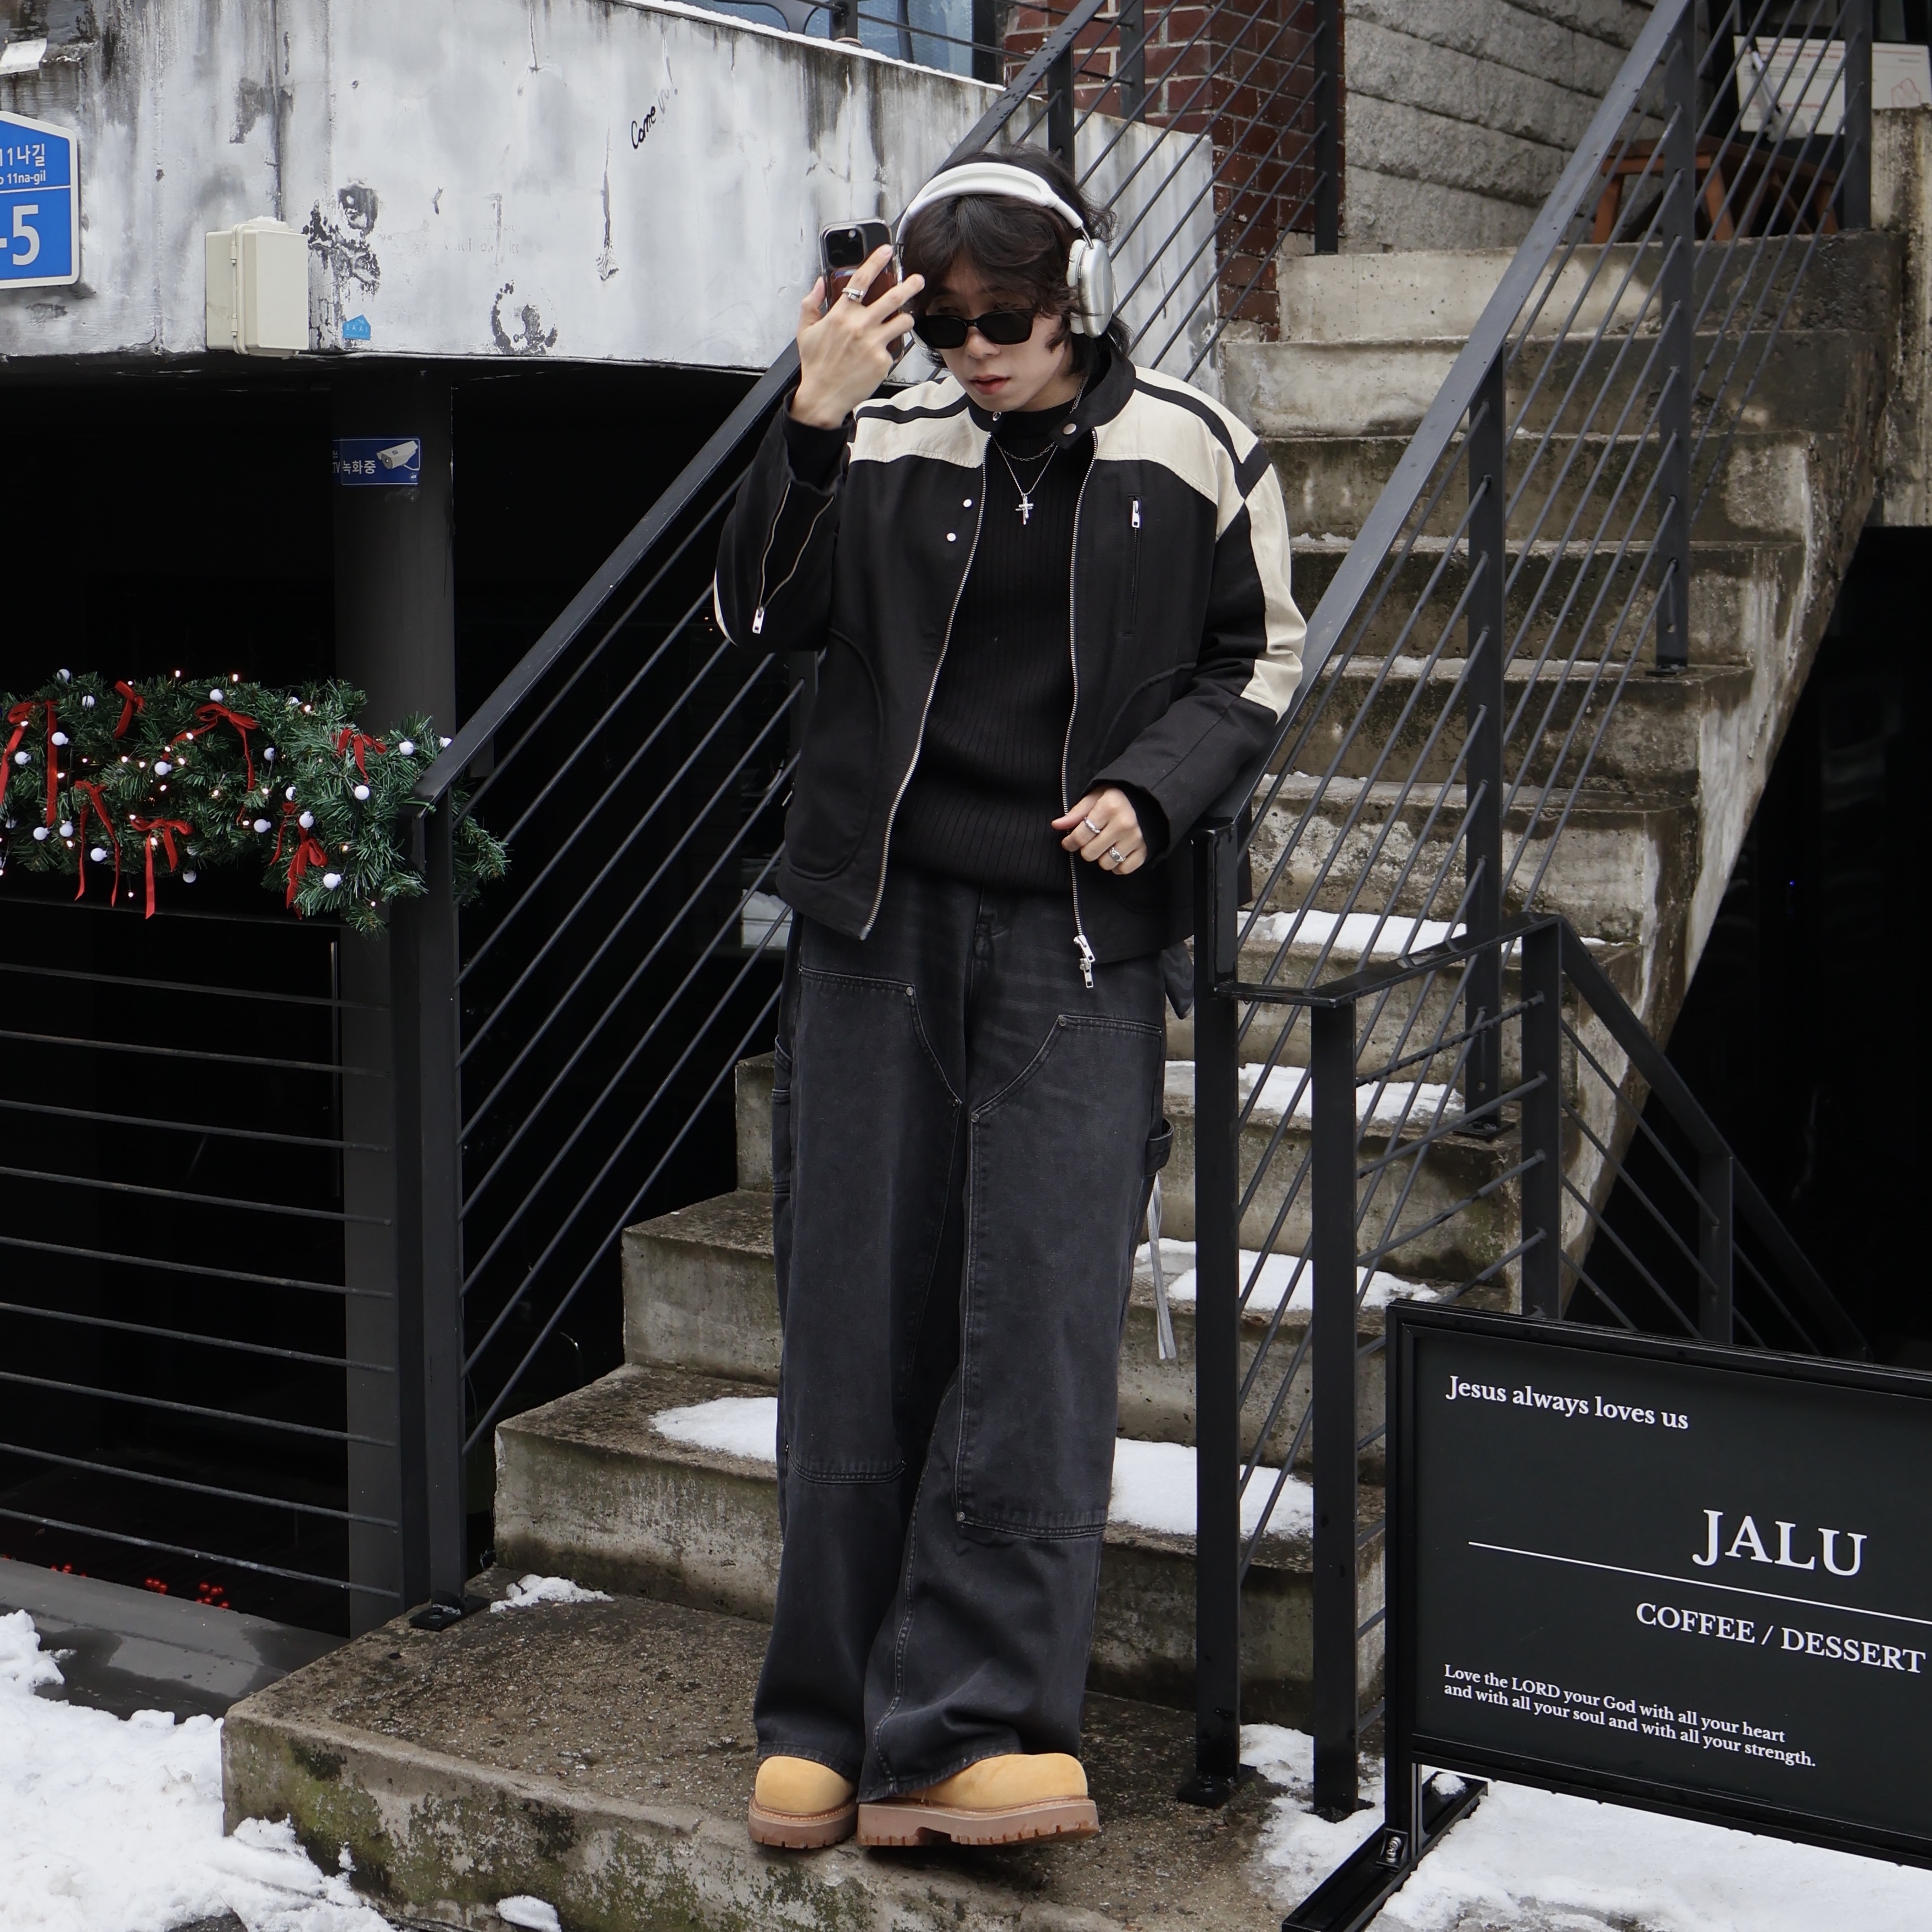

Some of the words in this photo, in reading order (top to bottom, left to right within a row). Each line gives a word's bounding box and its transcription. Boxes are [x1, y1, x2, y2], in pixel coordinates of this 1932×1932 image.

[631, 105, 657, 149] Come
[7, 169, 46, 185] 11na-gil
[342, 460, 376, 474] 녹화중
[1445, 1375, 1507, 1402] Jesus
[1512, 1386, 1589, 1417] always
[1594, 1395, 1655, 1425] loves
[1661, 1412, 1689, 1430] us
[1692, 1509, 1867, 1577] JALU
[1636, 1602, 1755, 1644] COFFEE
[1761, 1625, 1774, 1646] /
[1780, 1627, 1926, 1673] DESSERT
[1444, 1664, 1481, 1683] Love
[1484, 1672, 1508, 1688] the
[1511, 1677, 1560, 1698] LORD
[1563, 1690, 1601, 1706] your
[1603, 1695, 1637, 1714] God
[1639, 1704, 1675, 1721] with
[1678, 1710, 1698, 1726] all
[1700, 1717, 1740, 1733] your
[1742, 1721, 1785, 1743] heart
[1444, 1685, 1473, 1699] and
[1475, 1689, 1509, 1706] with
[1512, 1695, 1531, 1710] all
[1533, 1702, 1571, 1718] your
[1573, 1710, 1605, 1726] soul
[1608, 1717, 1638, 1732] and
[1641, 1722, 1677, 1739] with
[1680, 1728, 1700, 1744] all
[1702, 1735, 1741, 1752] your
[1744, 1743, 1816, 1767] strength.
